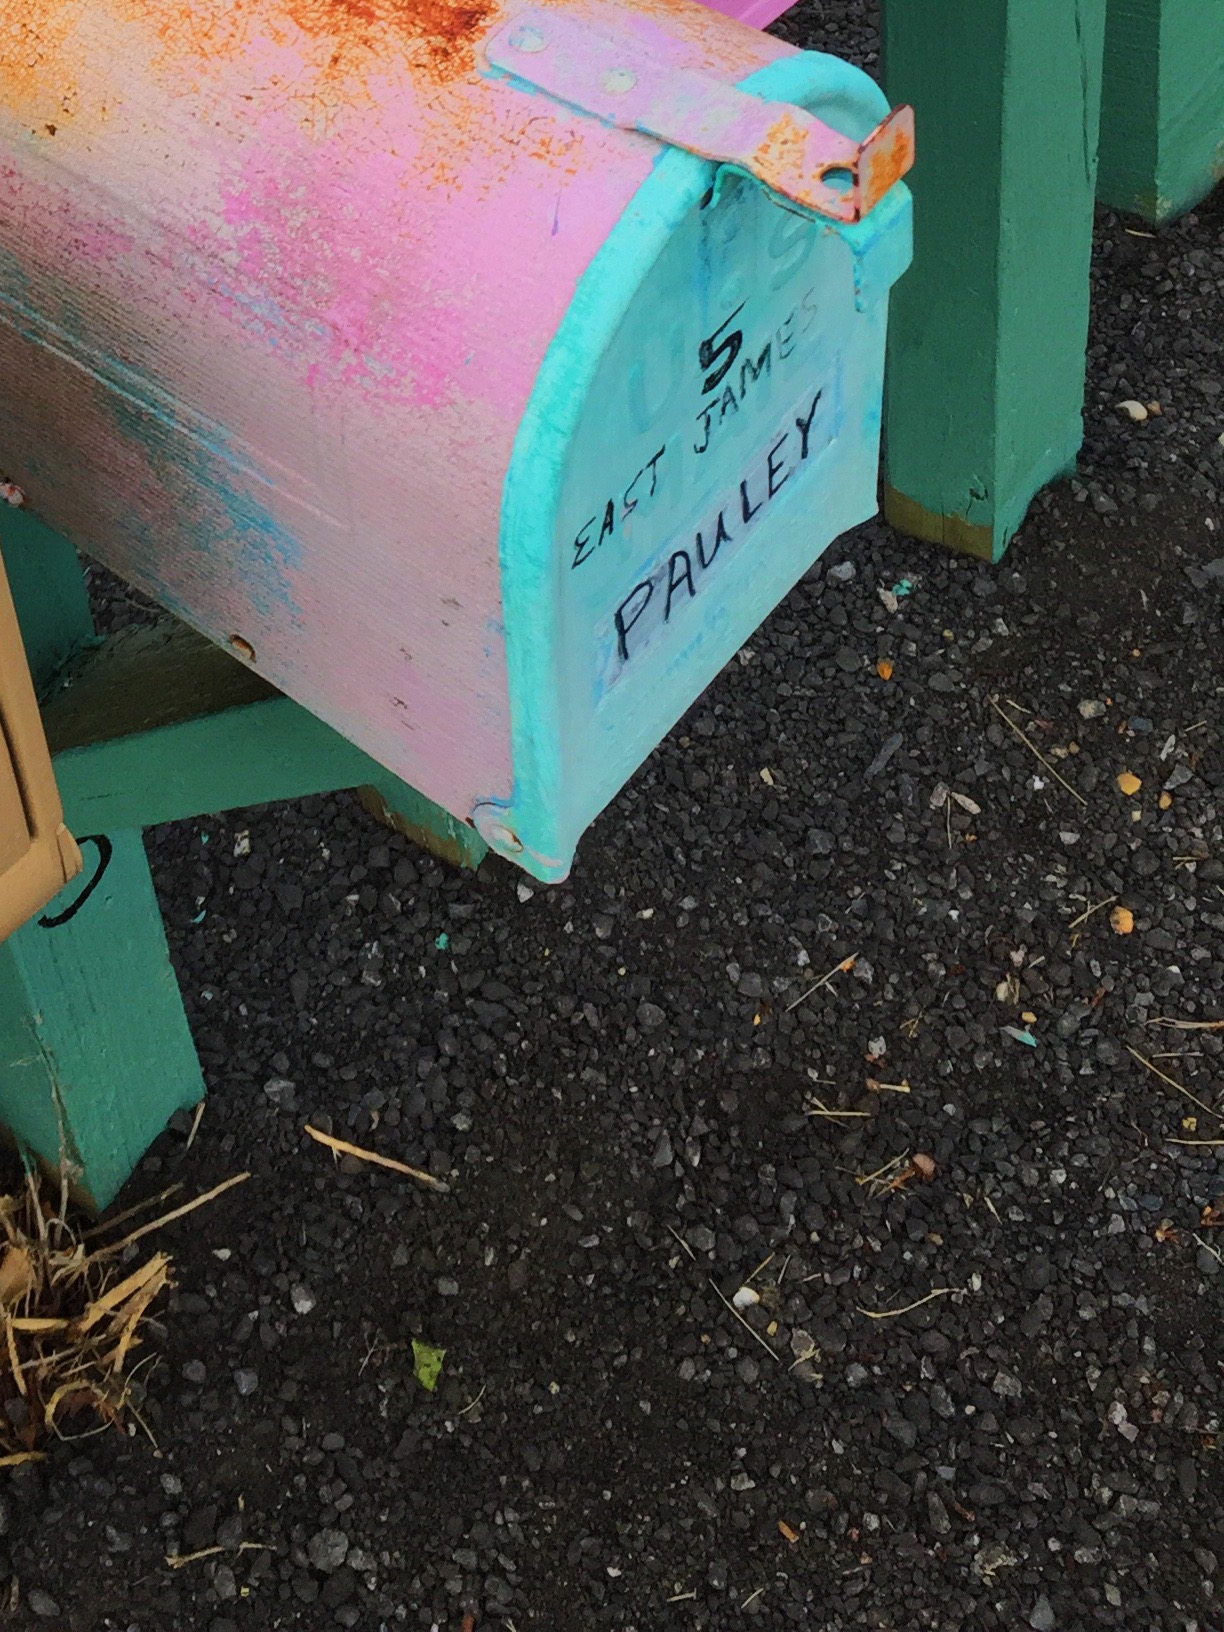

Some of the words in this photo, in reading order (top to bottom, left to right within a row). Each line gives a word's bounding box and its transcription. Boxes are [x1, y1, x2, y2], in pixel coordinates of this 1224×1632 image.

[571, 444, 665, 570] EAST
[693, 287, 818, 454] JAMES
[697, 295, 750, 396] 5
[614, 388, 824, 661] PAULEY
